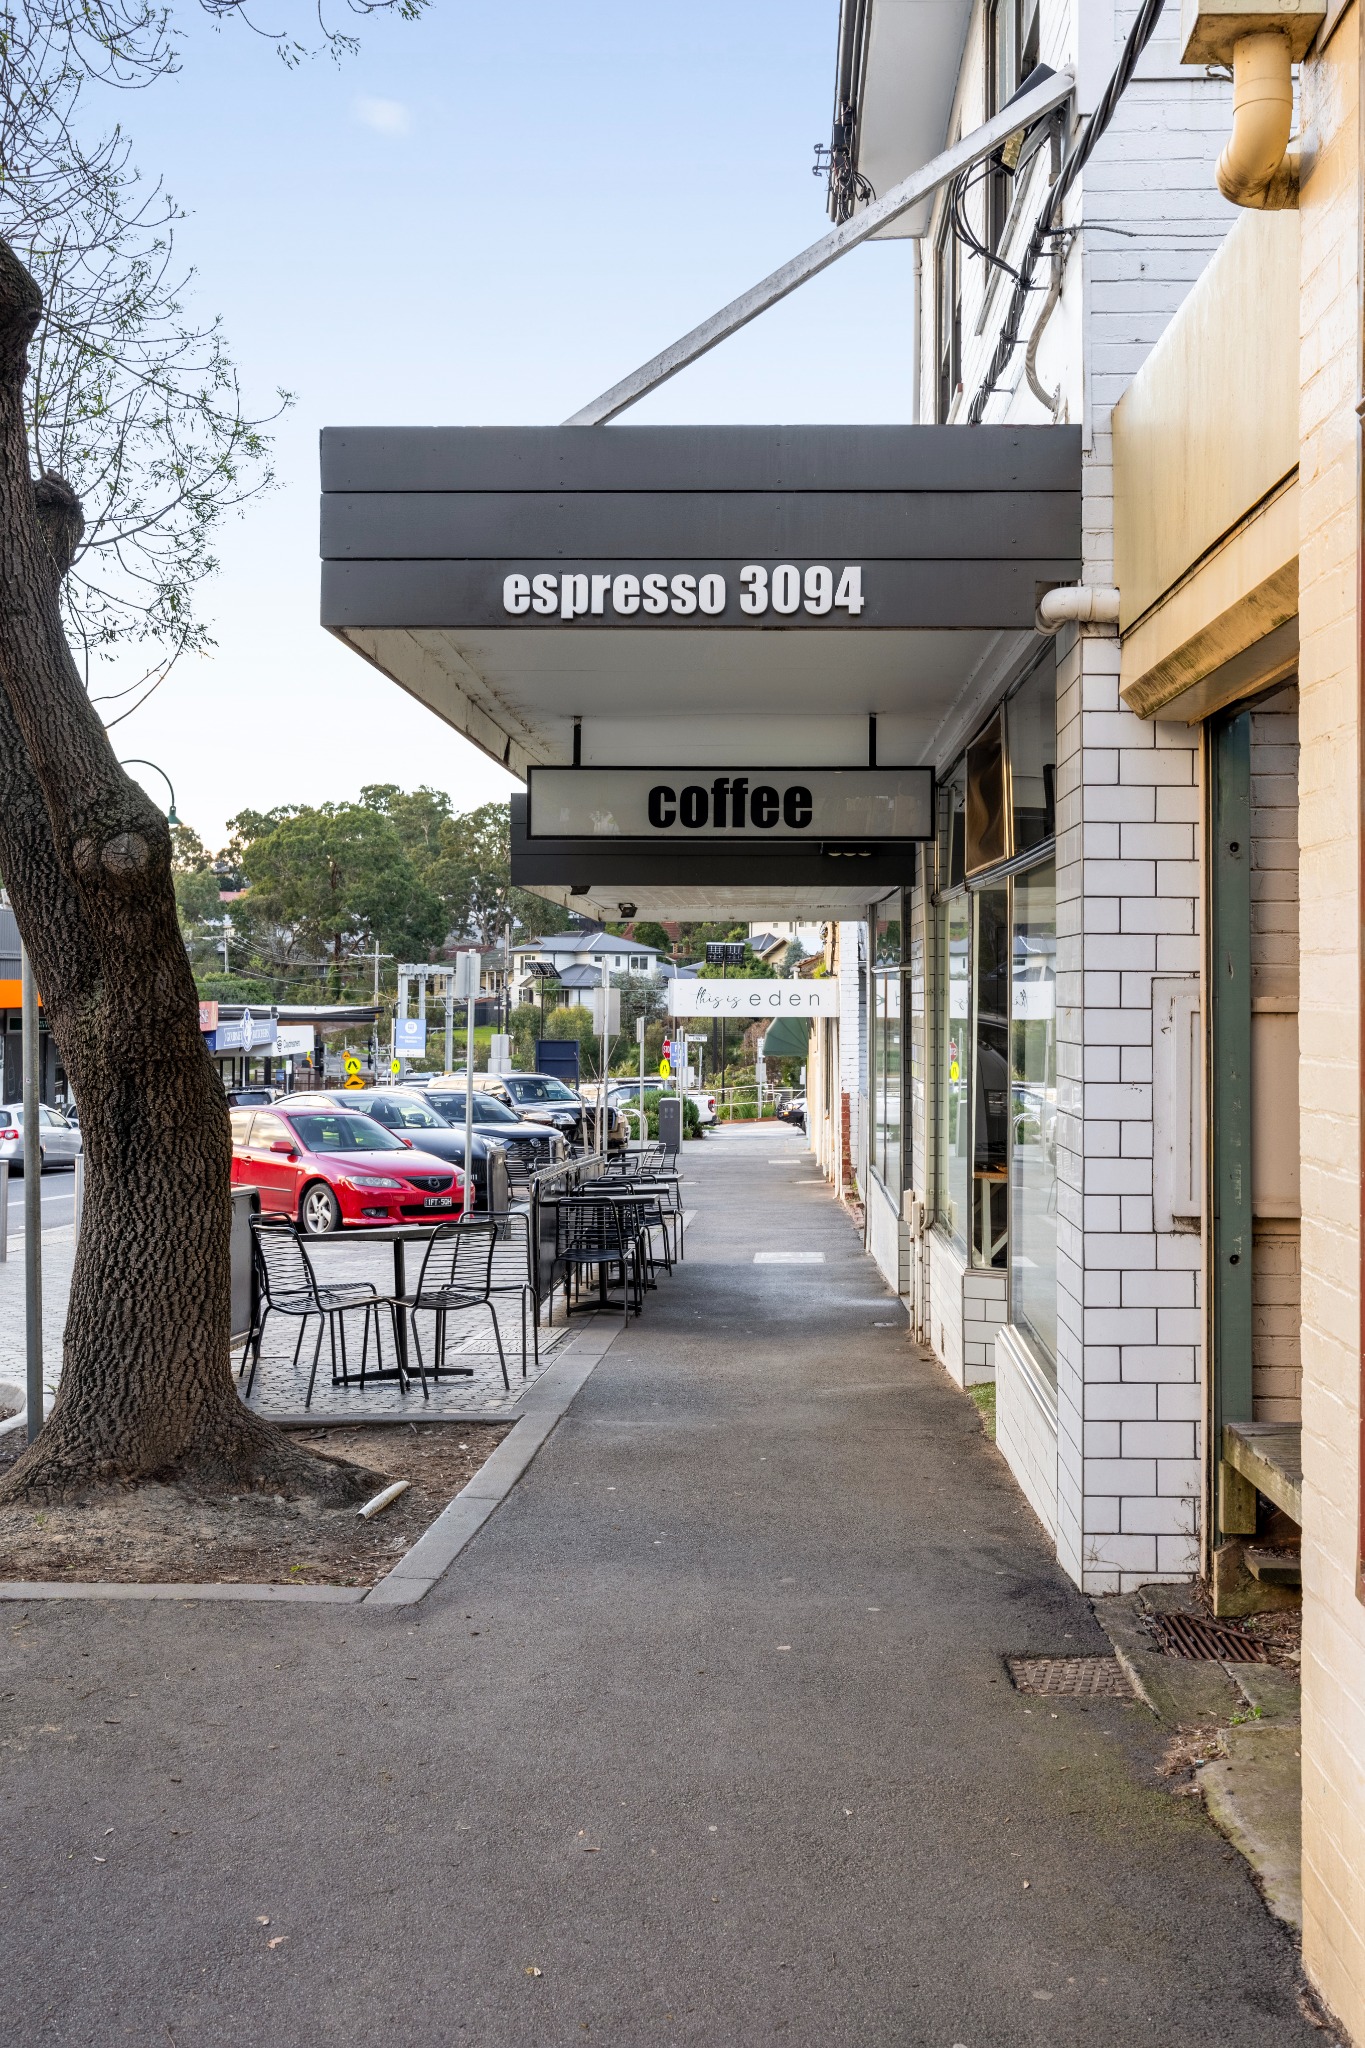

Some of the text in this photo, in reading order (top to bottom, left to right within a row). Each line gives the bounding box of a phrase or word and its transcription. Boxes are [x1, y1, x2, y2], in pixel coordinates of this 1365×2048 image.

[503, 564, 865, 619] espresso 3094
[648, 778, 812, 828] coffee
[692, 986, 820, 1010] this is eden
